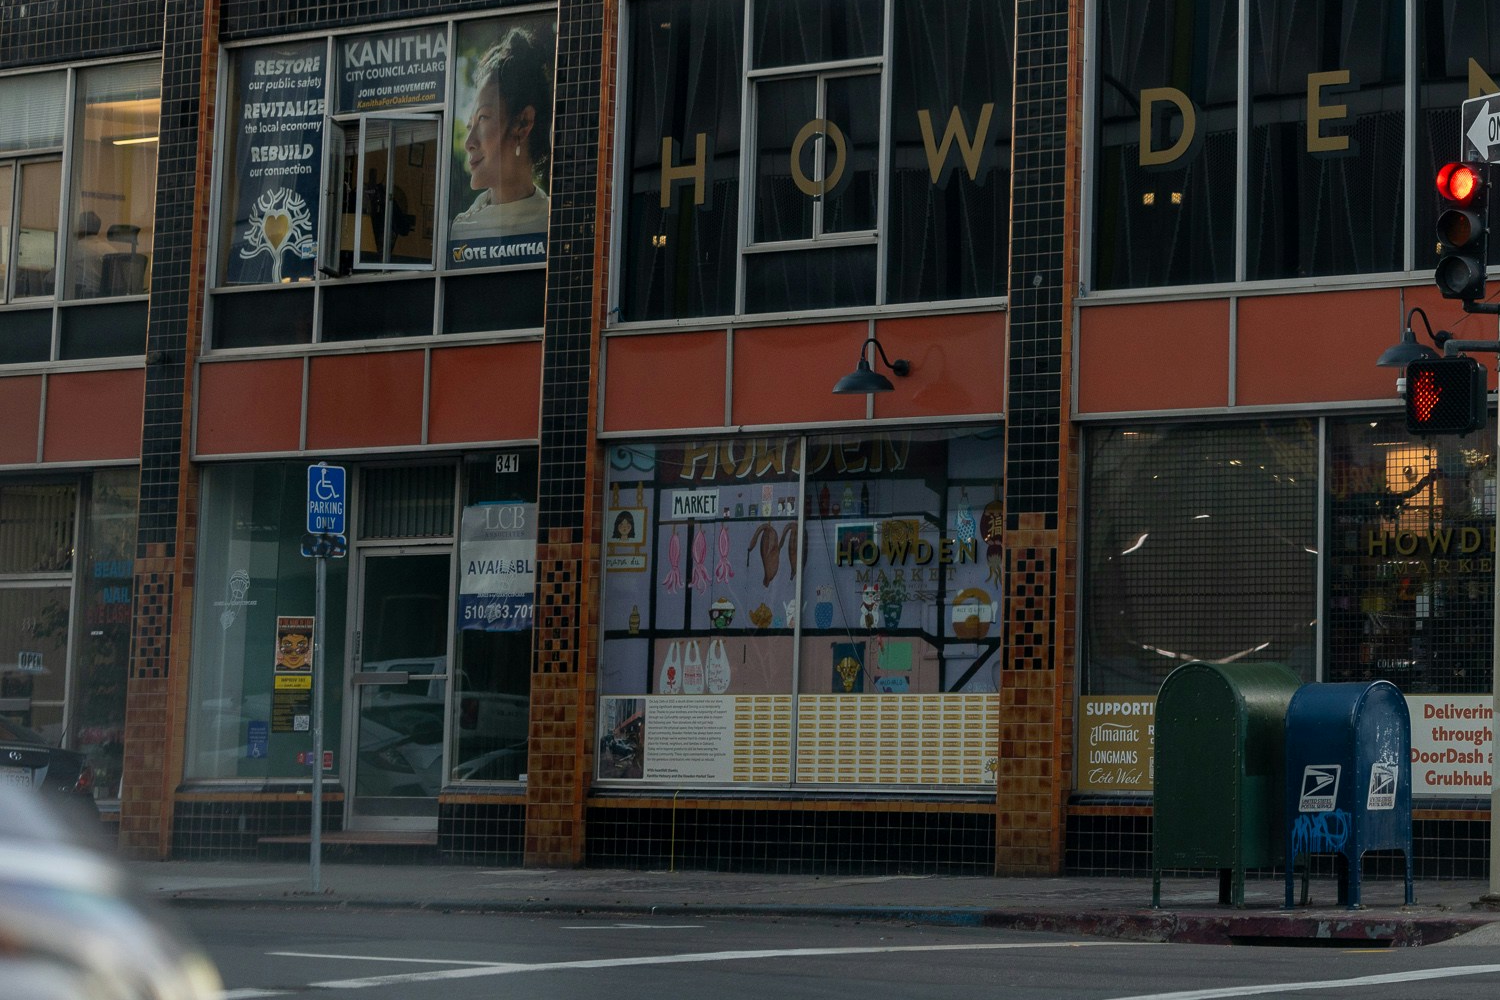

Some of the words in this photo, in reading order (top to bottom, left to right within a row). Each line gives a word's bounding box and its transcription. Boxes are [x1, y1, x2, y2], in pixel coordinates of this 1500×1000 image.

[344, 32, 447, 69] KANITHA
[254, 56, 320, 76] RESTORE
[345, 70, 364, 82] CITY
[366, 65, 405, 80] COUNCIL
[407, 60, 447, 75] AT-LARG
[249, 81, 264, 91] our
[265, 78, 296, 92] public
[297, 76, 322, 89] safety
[358, 88, 375, 98] JOIN
[377, 86, 392, 96] OUR
[244, 99, 325, 119] REVITALIZE
[357, 93, 436, 109] KanithaForOakland.com
[245, 122, 257, 134] the
[259, 121, 279, 133] local
[281, 121, 322, 132] economy
[251, 144, 314, 163] REBUILD
[249, 167, 262, 177] our
[264, 164, 312, 176] connection
[490, 241, 546, 258] KANITHA
[496, 454, 518, 473] 341
[309, 501, 343, 515] PARKING
[673, 495, 717, 515] MARKET
[316, 516, 336, 530] ONLY
[484, 506, 525, 530] LCB
[835, 538, 978, 567] HOWDEN
[467, 559, 533, 575] AVAILABL
[855, 567, 957, 583] MARKET
[20, 654, 42, 668] OPEN
[1086, 702, 1154, 716] SUPPORTI
[1424, 703, 1493, 719] Deliverin
[1090, 722, 1140, 746] Almanac
[1431, 726, 1493, 746] through
[1089, 750, 1138, 764] LONGMANS
[1410, 748, 1484, 764] DoorDash
[1115, 767, 1143, 784] West
[1425, 770, 1493, 786] Grubhub
